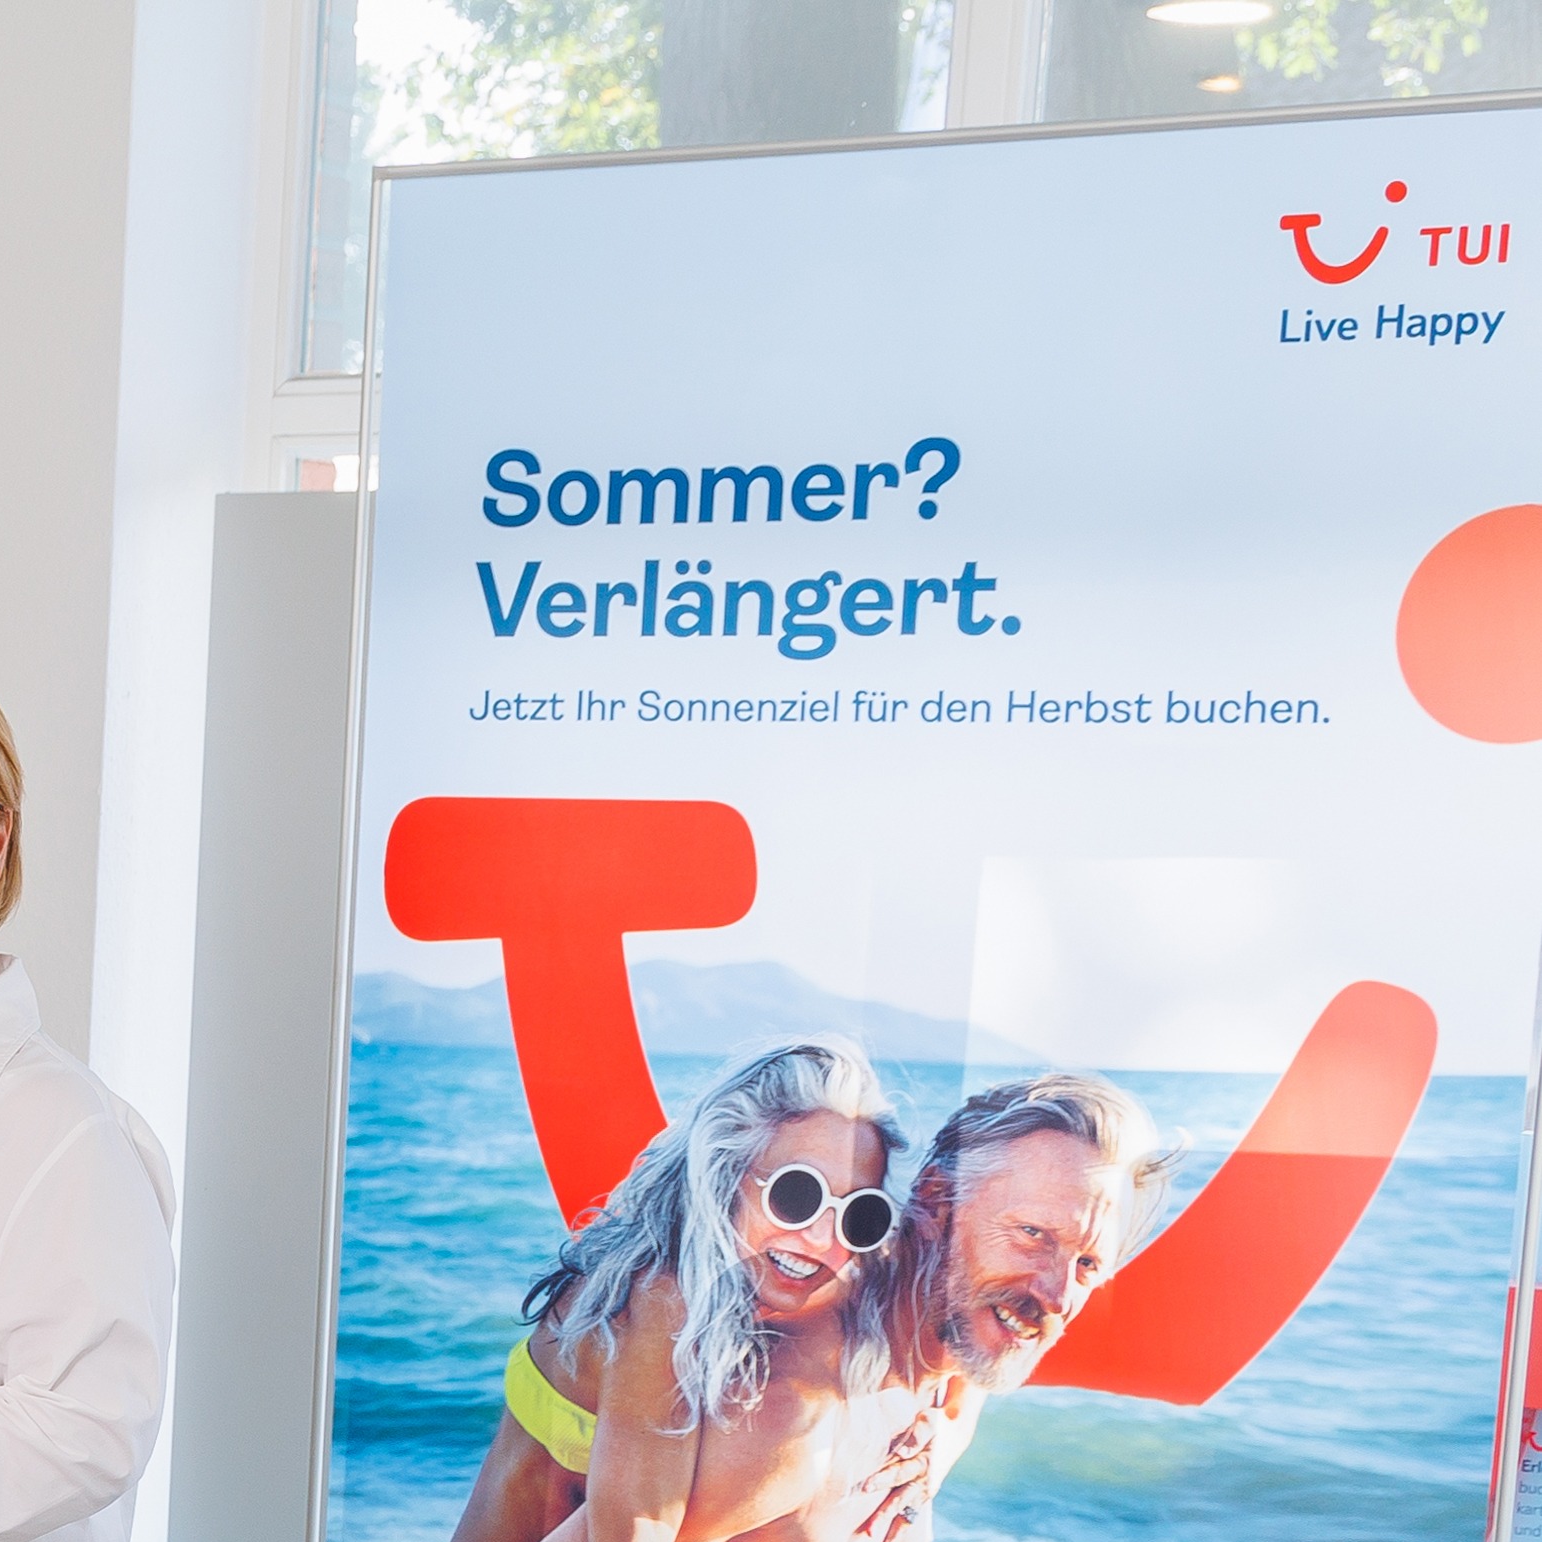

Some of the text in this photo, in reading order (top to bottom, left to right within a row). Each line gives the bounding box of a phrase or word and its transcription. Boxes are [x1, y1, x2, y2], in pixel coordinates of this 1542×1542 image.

[1419, 223, 1510, 267] TUI
[1279, 304, 1506, 346] Live Happy
[482, 437, 962, 528] Sommer?
[476, 559, 1023, 661] Verlängert.
[469, 690, 1331, 725] Jetzt Ihr Sonnenziel für den Herbst buchen.
